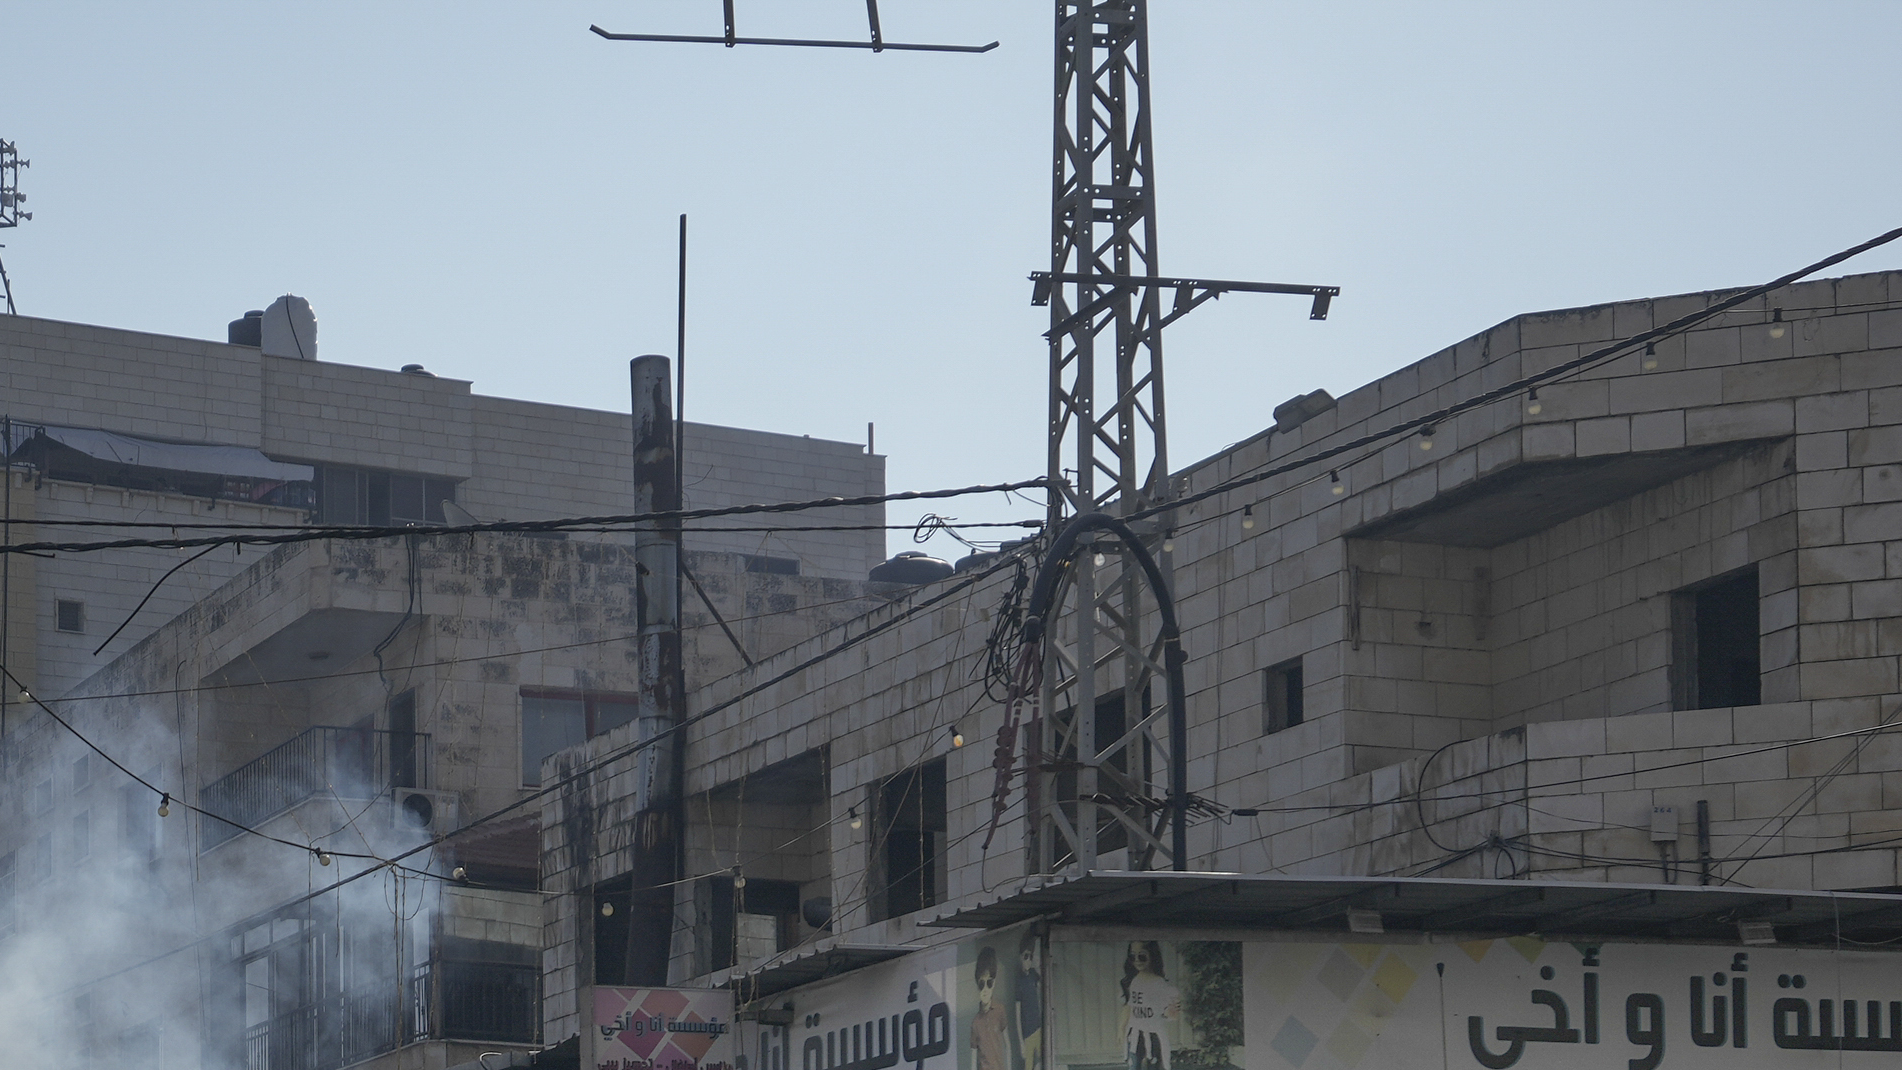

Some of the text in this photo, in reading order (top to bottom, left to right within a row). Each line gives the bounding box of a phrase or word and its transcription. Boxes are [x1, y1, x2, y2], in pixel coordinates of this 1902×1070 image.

[1131, 991, 1144, 1004] BE
[1690, 952, 1748, 1049] أنا
[649, 1011, 665, 1032] أنا
[1132, 1006, 1154, 1019] KIND
[600, 1011, 632, 1041] أخي
